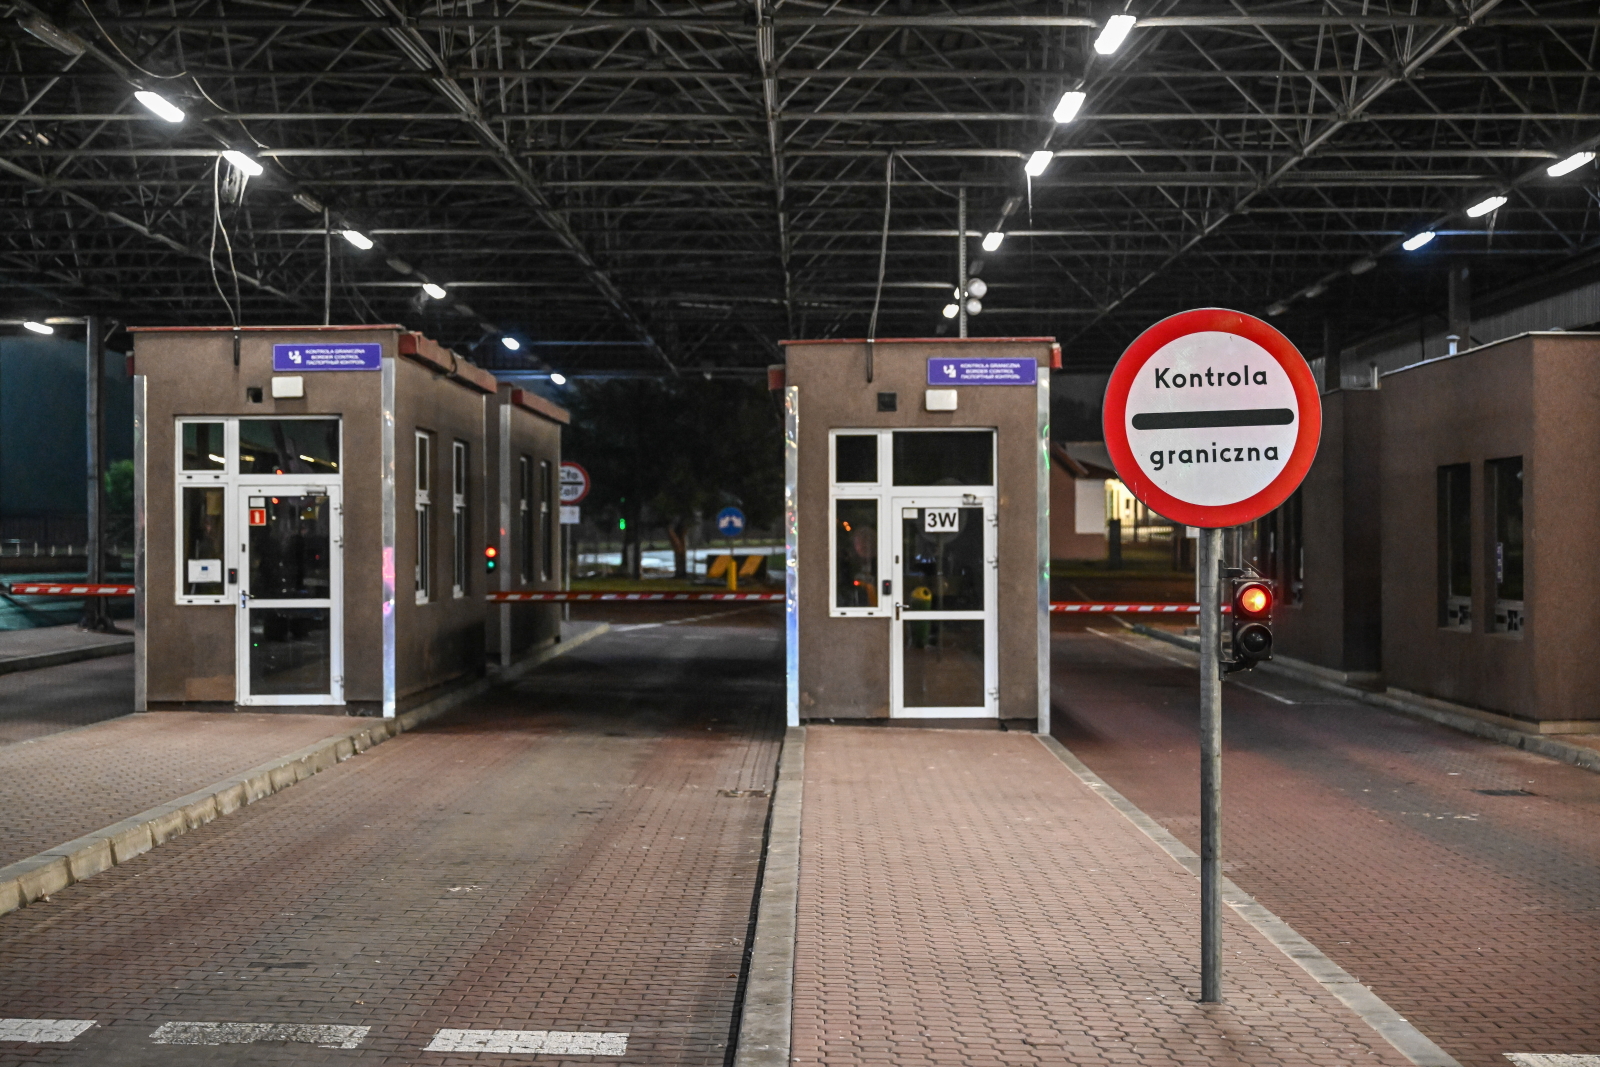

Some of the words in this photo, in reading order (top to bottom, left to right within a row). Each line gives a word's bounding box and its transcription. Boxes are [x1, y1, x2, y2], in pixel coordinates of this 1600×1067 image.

[1154, 365, 1267, 389] Kontrola
[1150, 442, 1279, 471] graniczna
[927, 512, 957, 528] 3W
